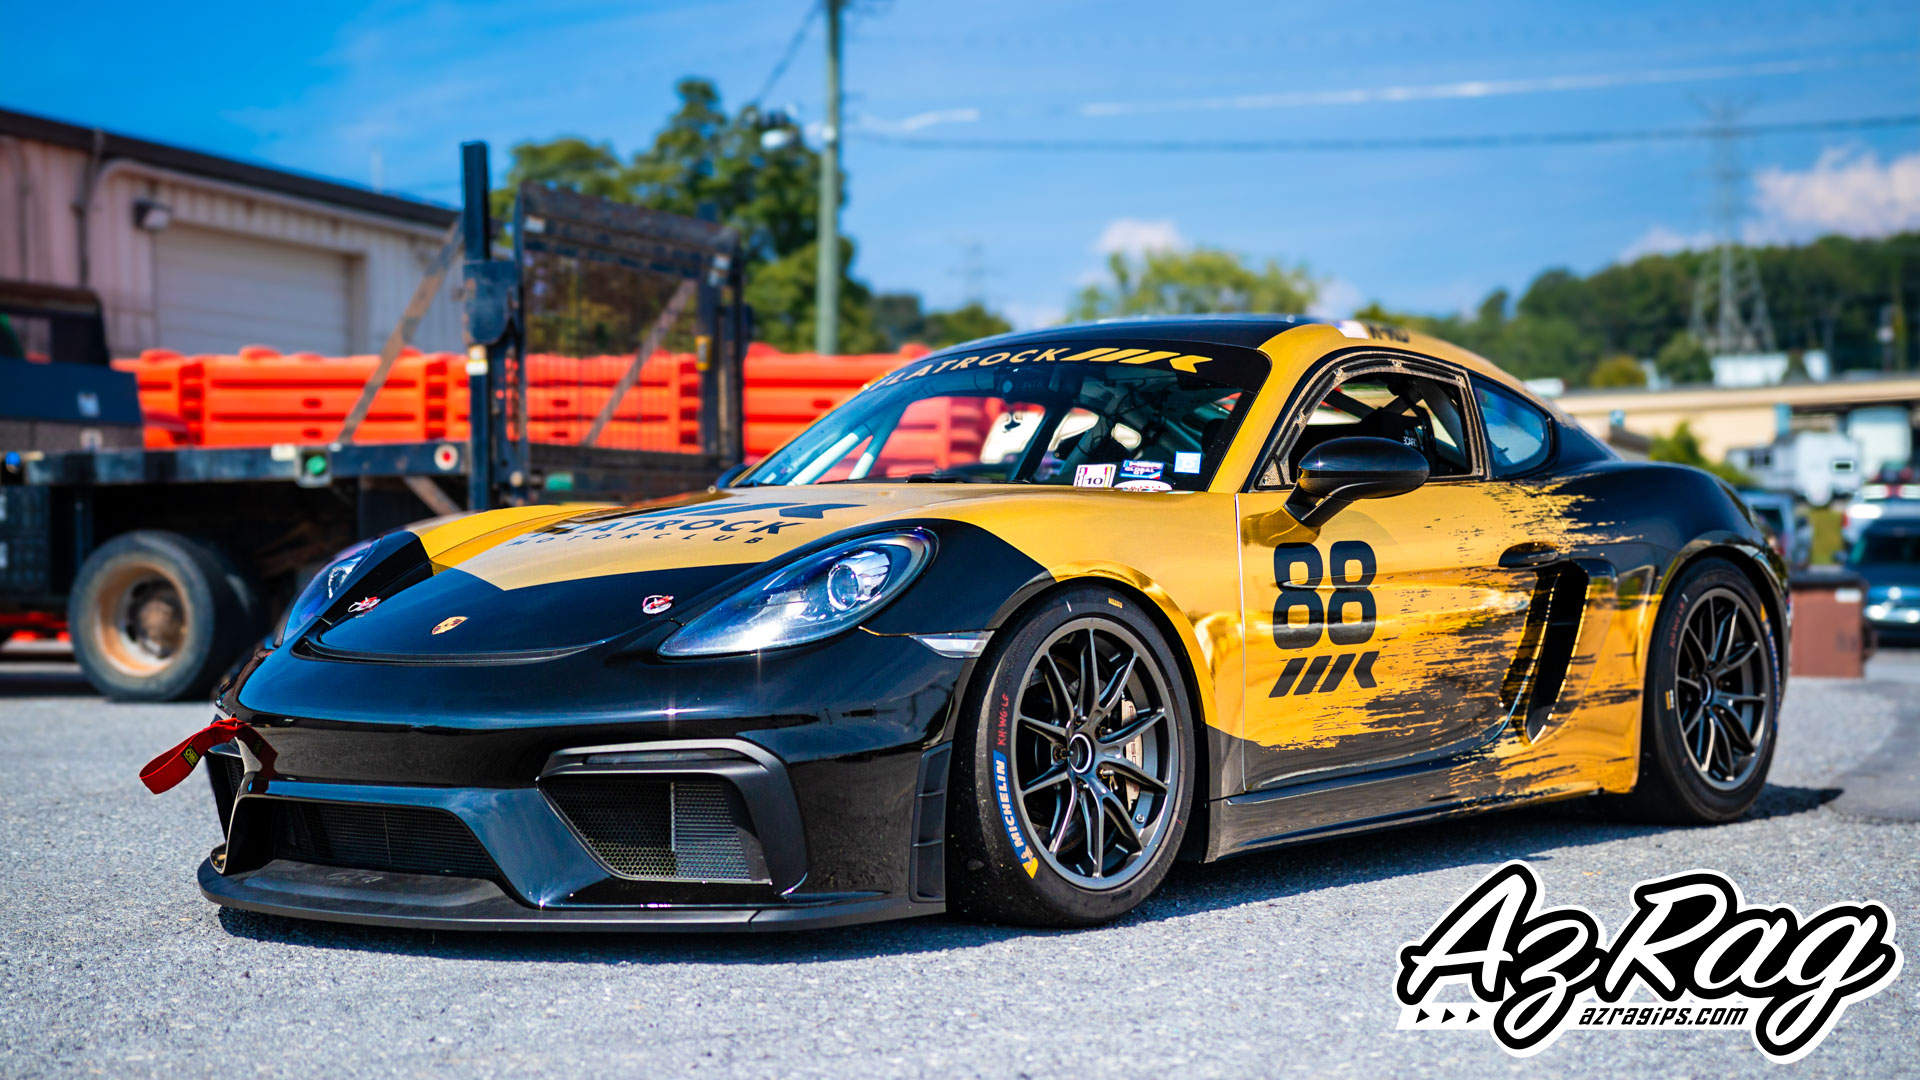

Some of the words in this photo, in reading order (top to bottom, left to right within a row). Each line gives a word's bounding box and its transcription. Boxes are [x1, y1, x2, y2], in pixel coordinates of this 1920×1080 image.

[869, 347, 1071, 392] FLATROCK
[1085, 477, 1104, 485] 10
[1273, 540, 1377, 650] 88
[995, 759, 1025, 848] MICHELIN
